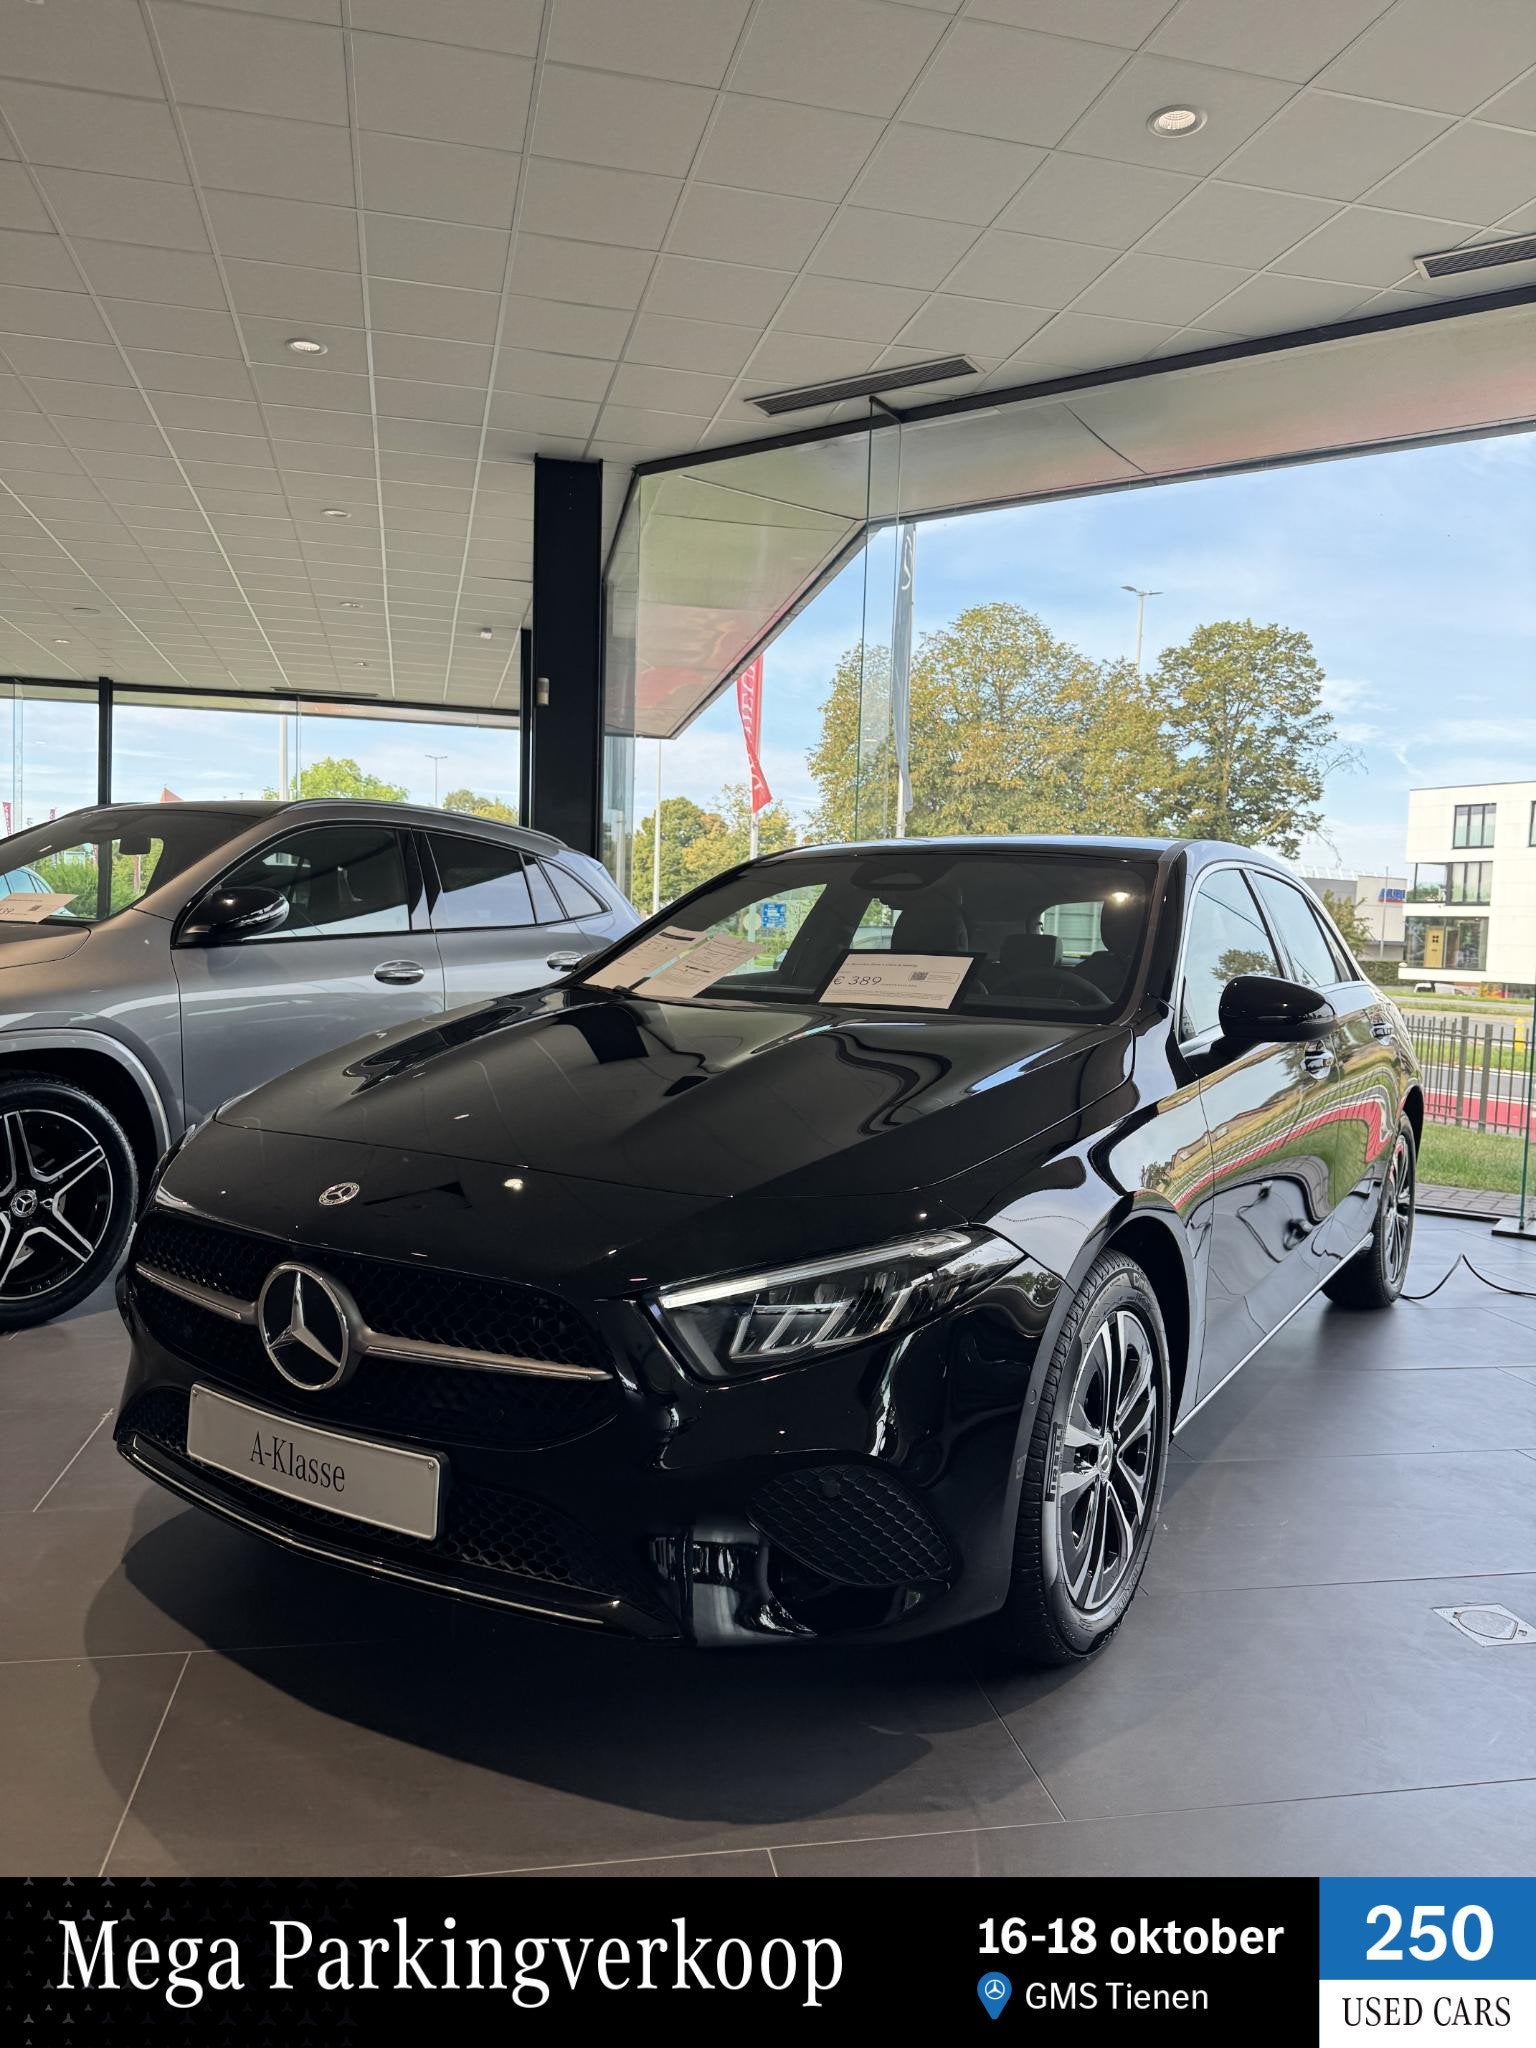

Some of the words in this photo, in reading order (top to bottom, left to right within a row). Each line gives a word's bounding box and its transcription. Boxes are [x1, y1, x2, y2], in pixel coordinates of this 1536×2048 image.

[833, 975, 846, 985] €
[848, 975, 882, 986] 389
[248, 1430, 346, 1493] A-Klasse
